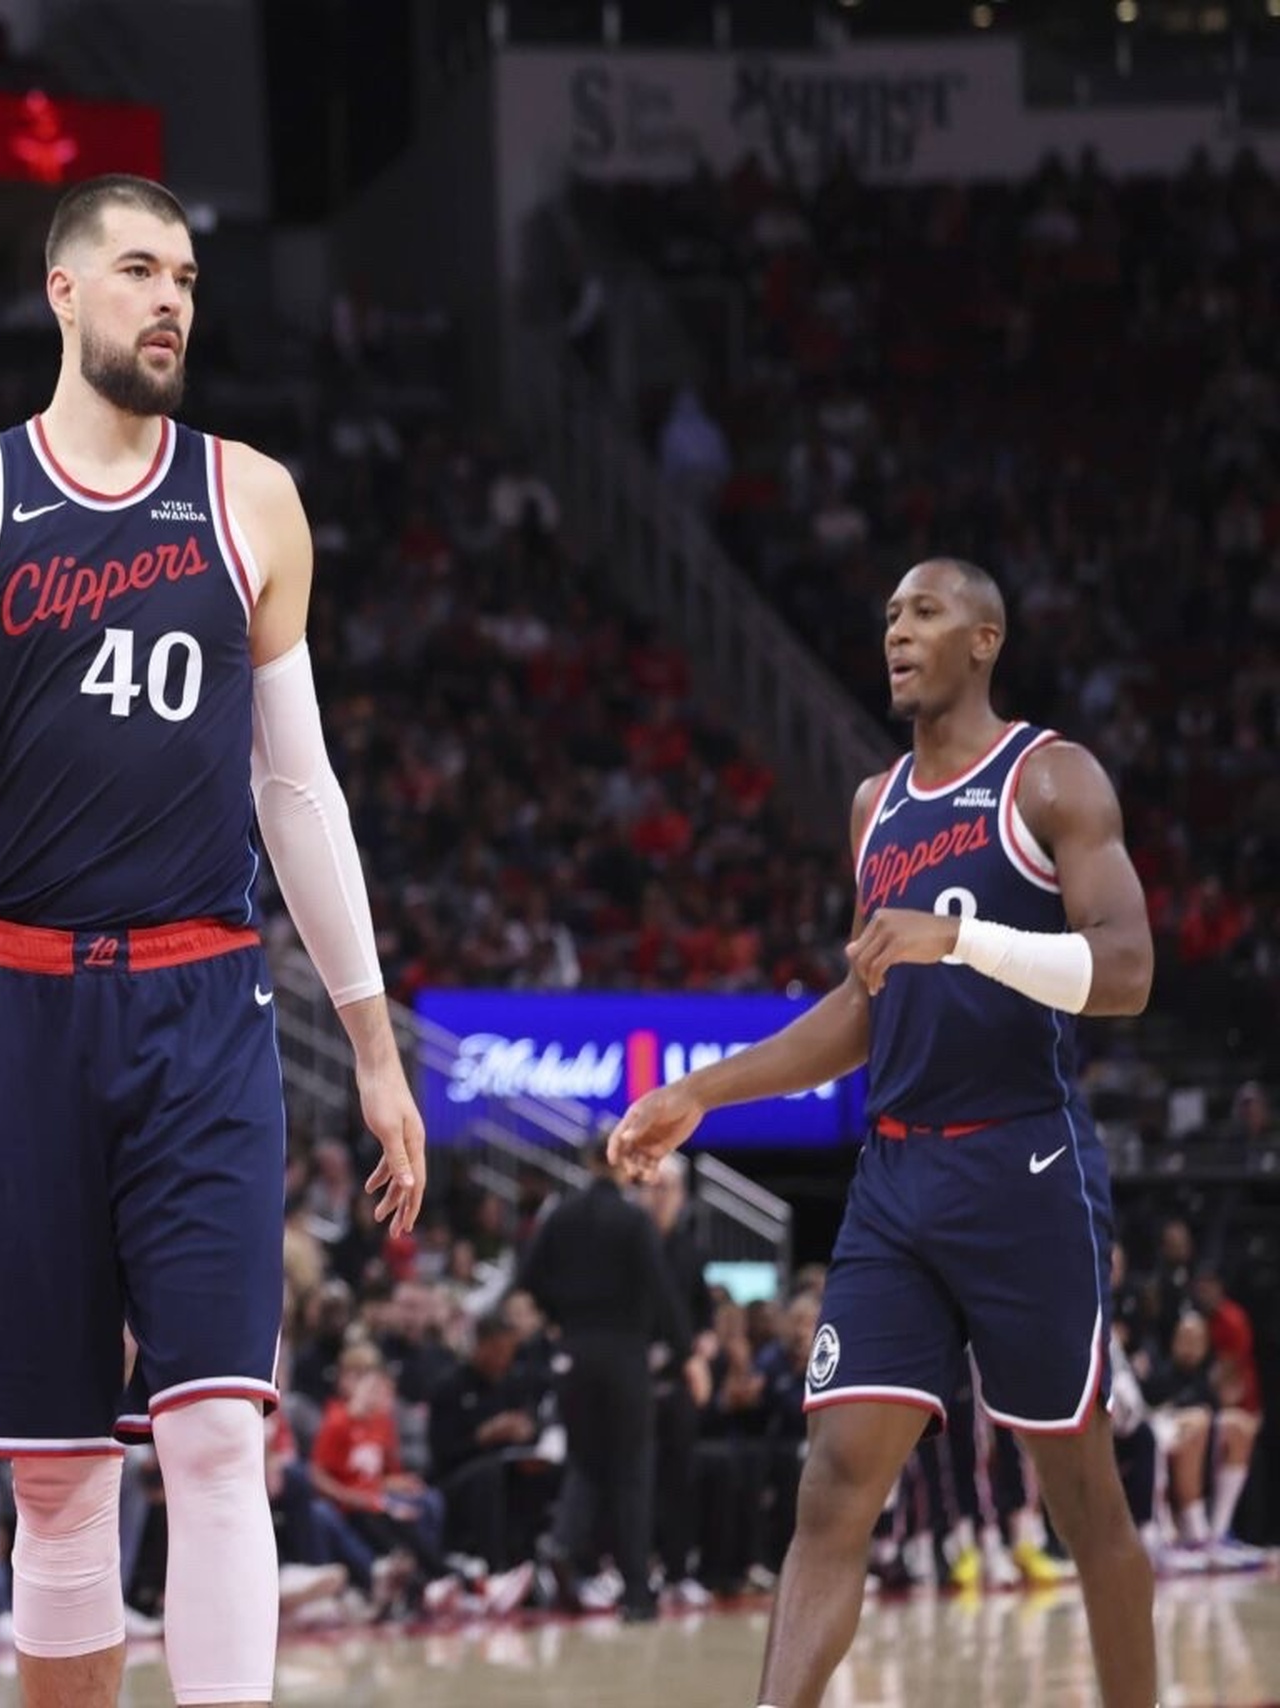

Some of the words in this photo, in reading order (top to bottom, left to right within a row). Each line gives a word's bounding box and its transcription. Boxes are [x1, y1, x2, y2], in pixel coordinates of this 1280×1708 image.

[151, 509, 207, 521] RWANDA
[161, 500, 193, 511] VISIT
[2, 536, 209, 635] Clippers
[80, 628, 203, 722] 40
[857, 815, 989, 916] Clippers
